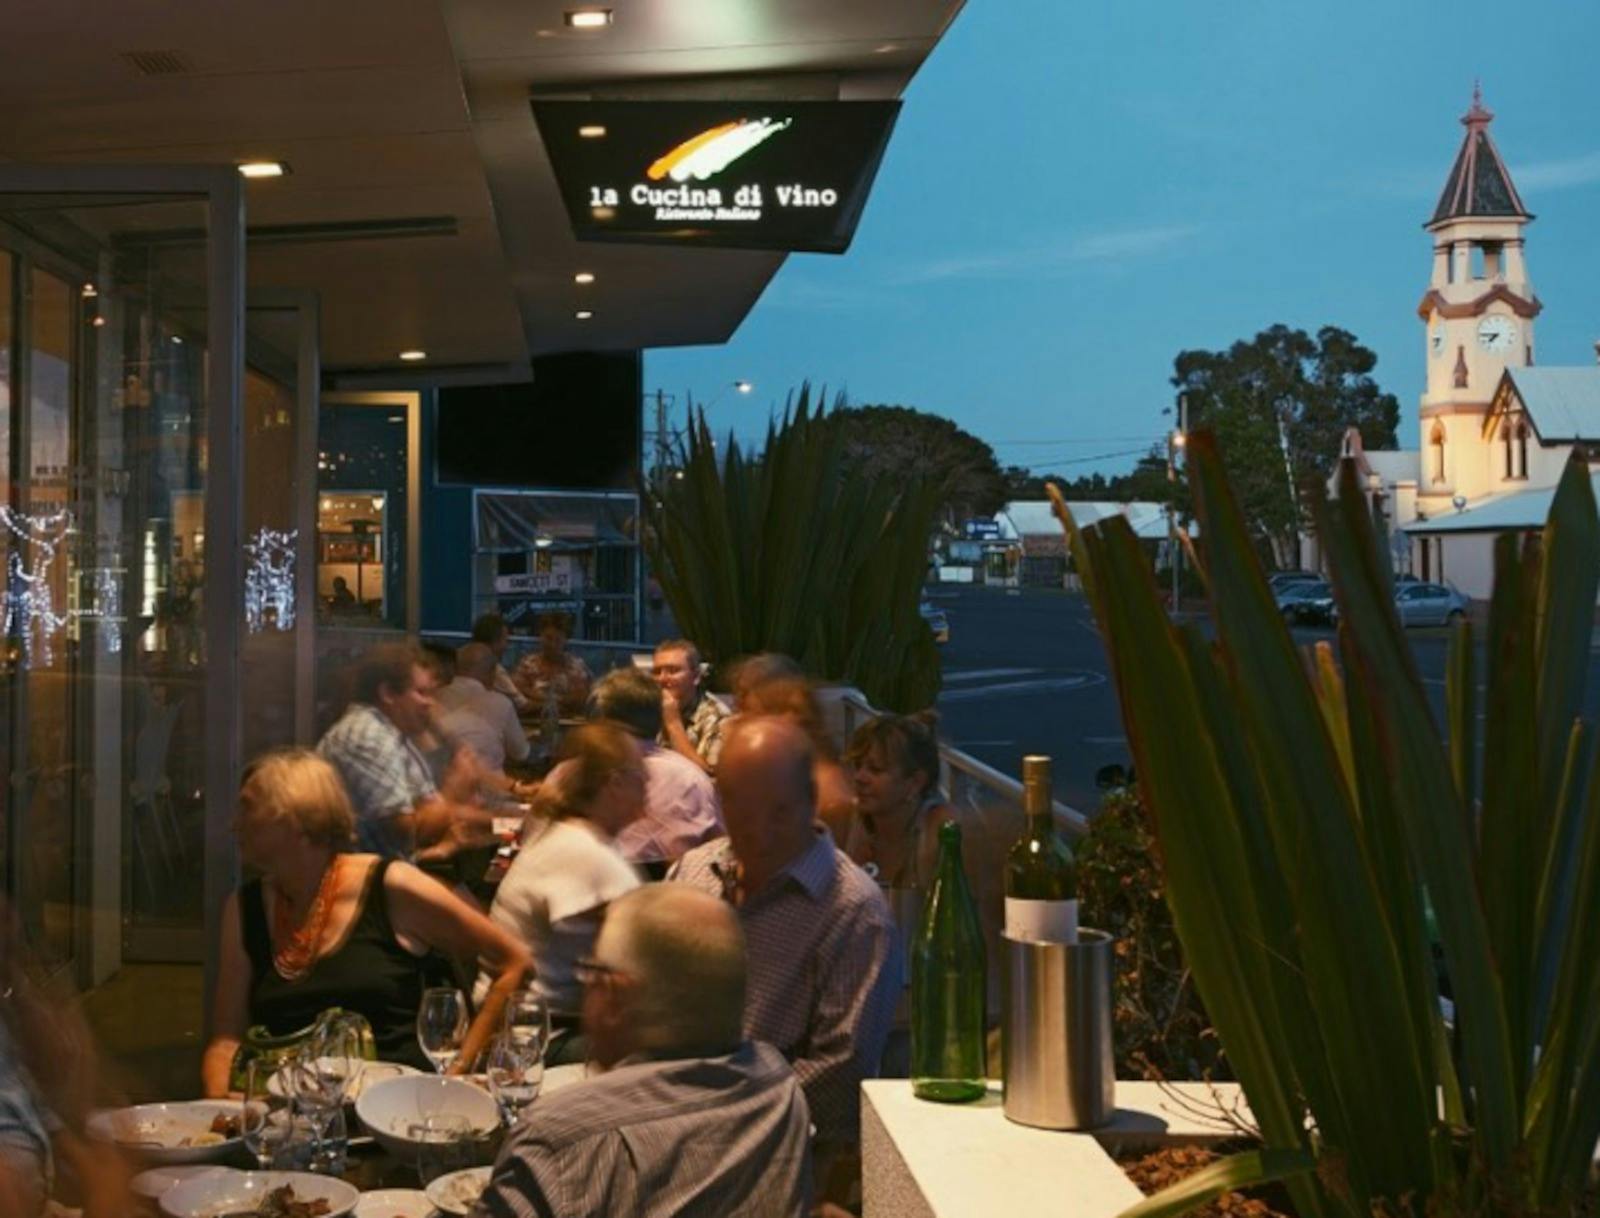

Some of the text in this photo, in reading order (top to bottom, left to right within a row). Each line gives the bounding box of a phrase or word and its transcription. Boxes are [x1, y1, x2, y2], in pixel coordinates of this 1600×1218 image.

[590, 184, 838, 206] la Cucina di Vino
